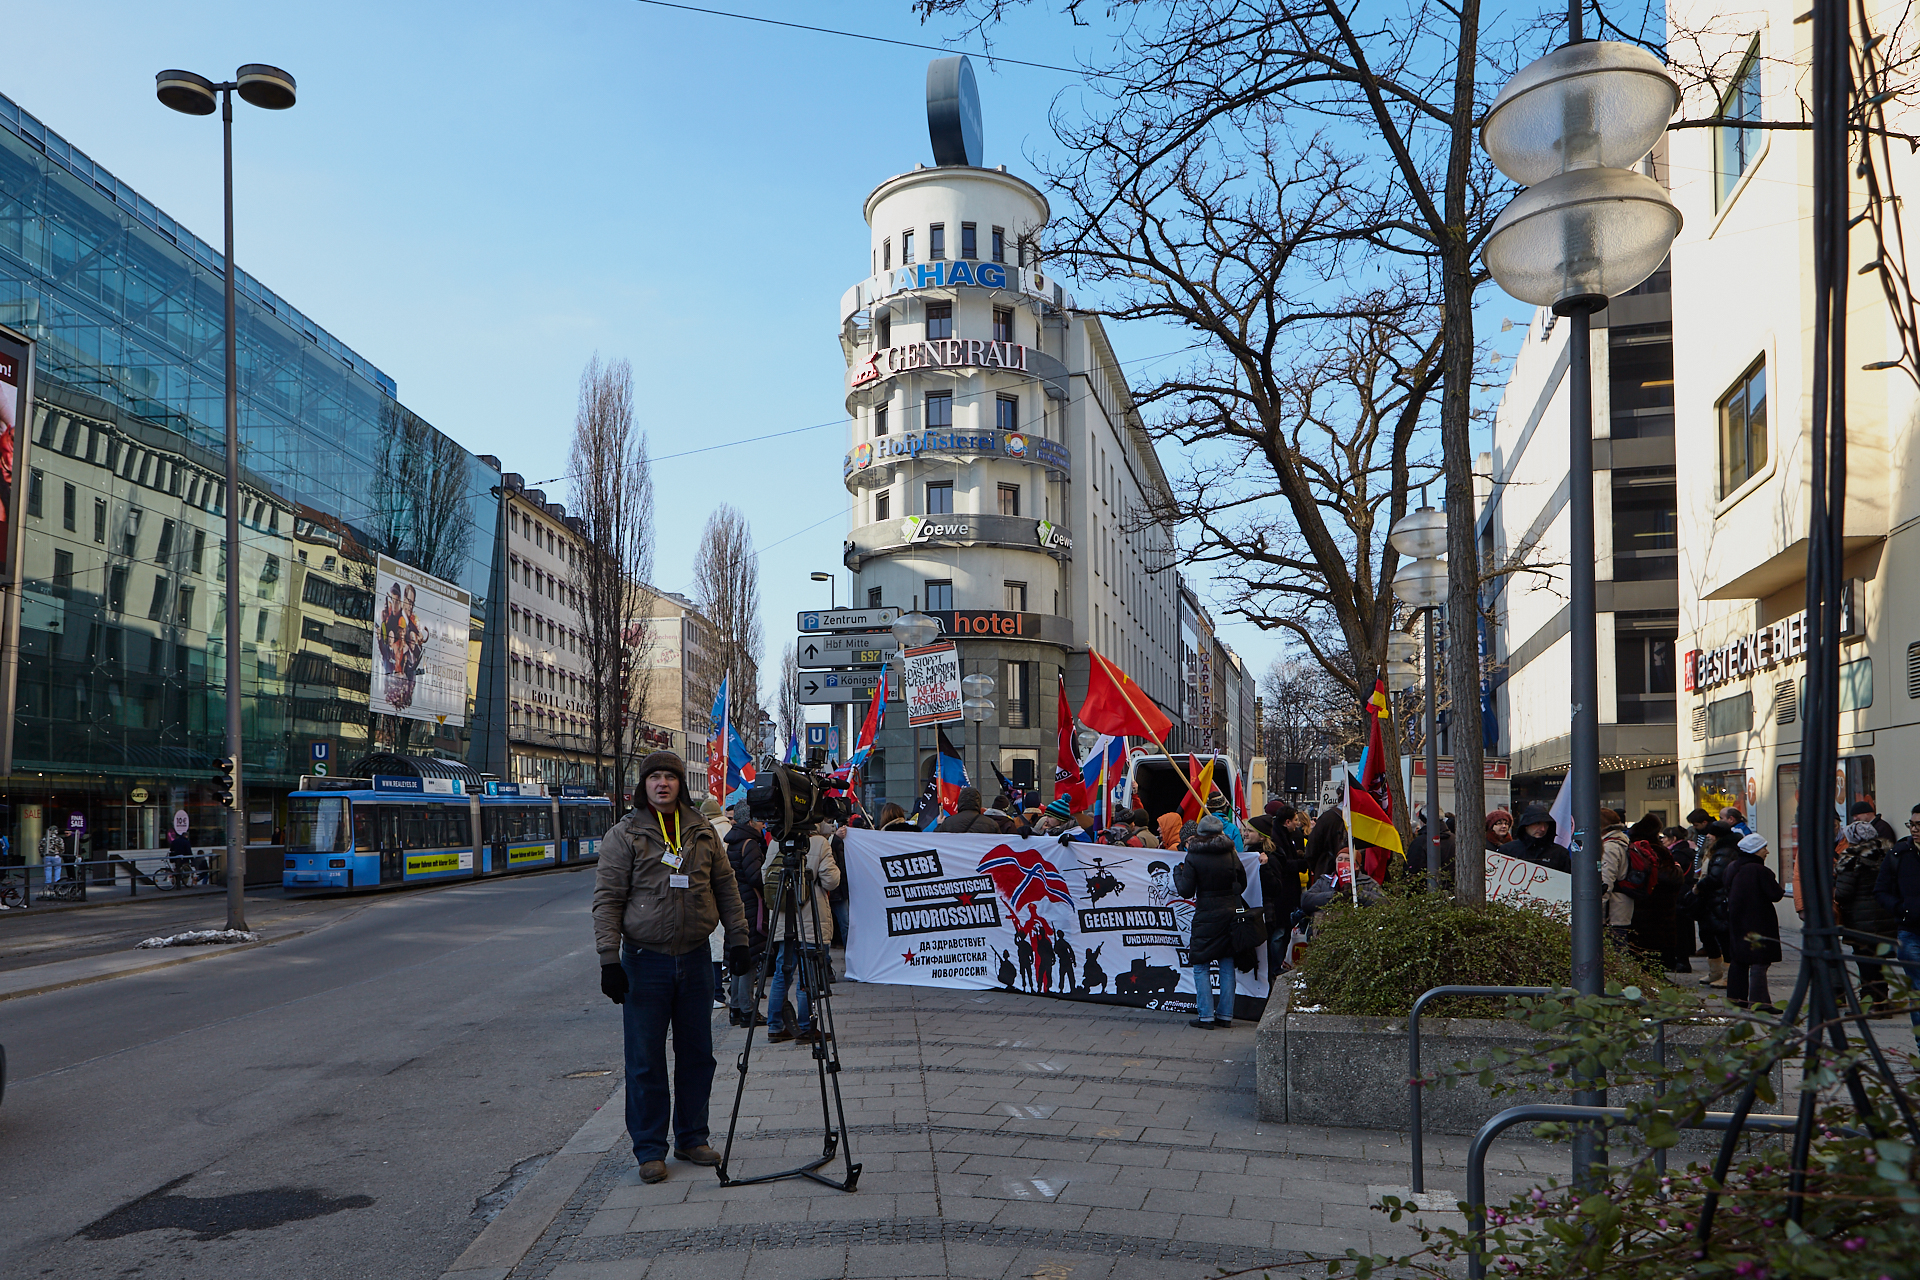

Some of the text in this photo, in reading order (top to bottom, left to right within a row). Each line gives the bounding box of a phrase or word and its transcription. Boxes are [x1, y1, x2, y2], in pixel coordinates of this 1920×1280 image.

[865, 261, 1006, 304] MAHAG
[885, 339, 1028, 373] GENERALI
[877, 431, 996, 458] Hofpfisterei
[910, 518, 969, 544] Loewe
[823, 615, 867, 625] Zentrum
[955, 612, 1022, 635] hotel
[826, 639, 869, 649] Hbf Mitte
[860, 651, 880, 662] 697
[911, 654, 944, 669] STOPPT
[1697, 626, 1768, 688] BESTECKE
[423, 656, 462, 682] Kingsman
[907, 662, 956, 680] DAS MORDEN
[841, 676, 880, 686] Königsh
[906, 677, 925, 688] WEG
[867, 688, 897, 698] 4 rei
[917, 682, 946, 696] KIEWER
[1201, 663, 1210, 747] APOTHEKE
[812, 729, 822, 743] U
[315, 745, 326, 758] U
[314, 762, 327, 777] S
[24, 809, 41, 819] SALE
[886, 855, 938, 878] ES LEBE
[1485, 854, 1548, 891] STOP
[886, 878, 993, 899] DAS ANTIFASCHISTISCHE
[890, 903, 996, 932] NOVOROSSIYA!
[1084, 910, 1173, 929] GEGEN NATO, EU
[919, 936, 987, 952] ДА ЗДРАВСТВУЕТ
[1126, 934, 1181, 945] UND UKRAINISCHE
[910, 952, 988, 967] АНТИФАШИСТСКАЯ
[932, 966, 988, 979] НОВОРОССИЯ!
